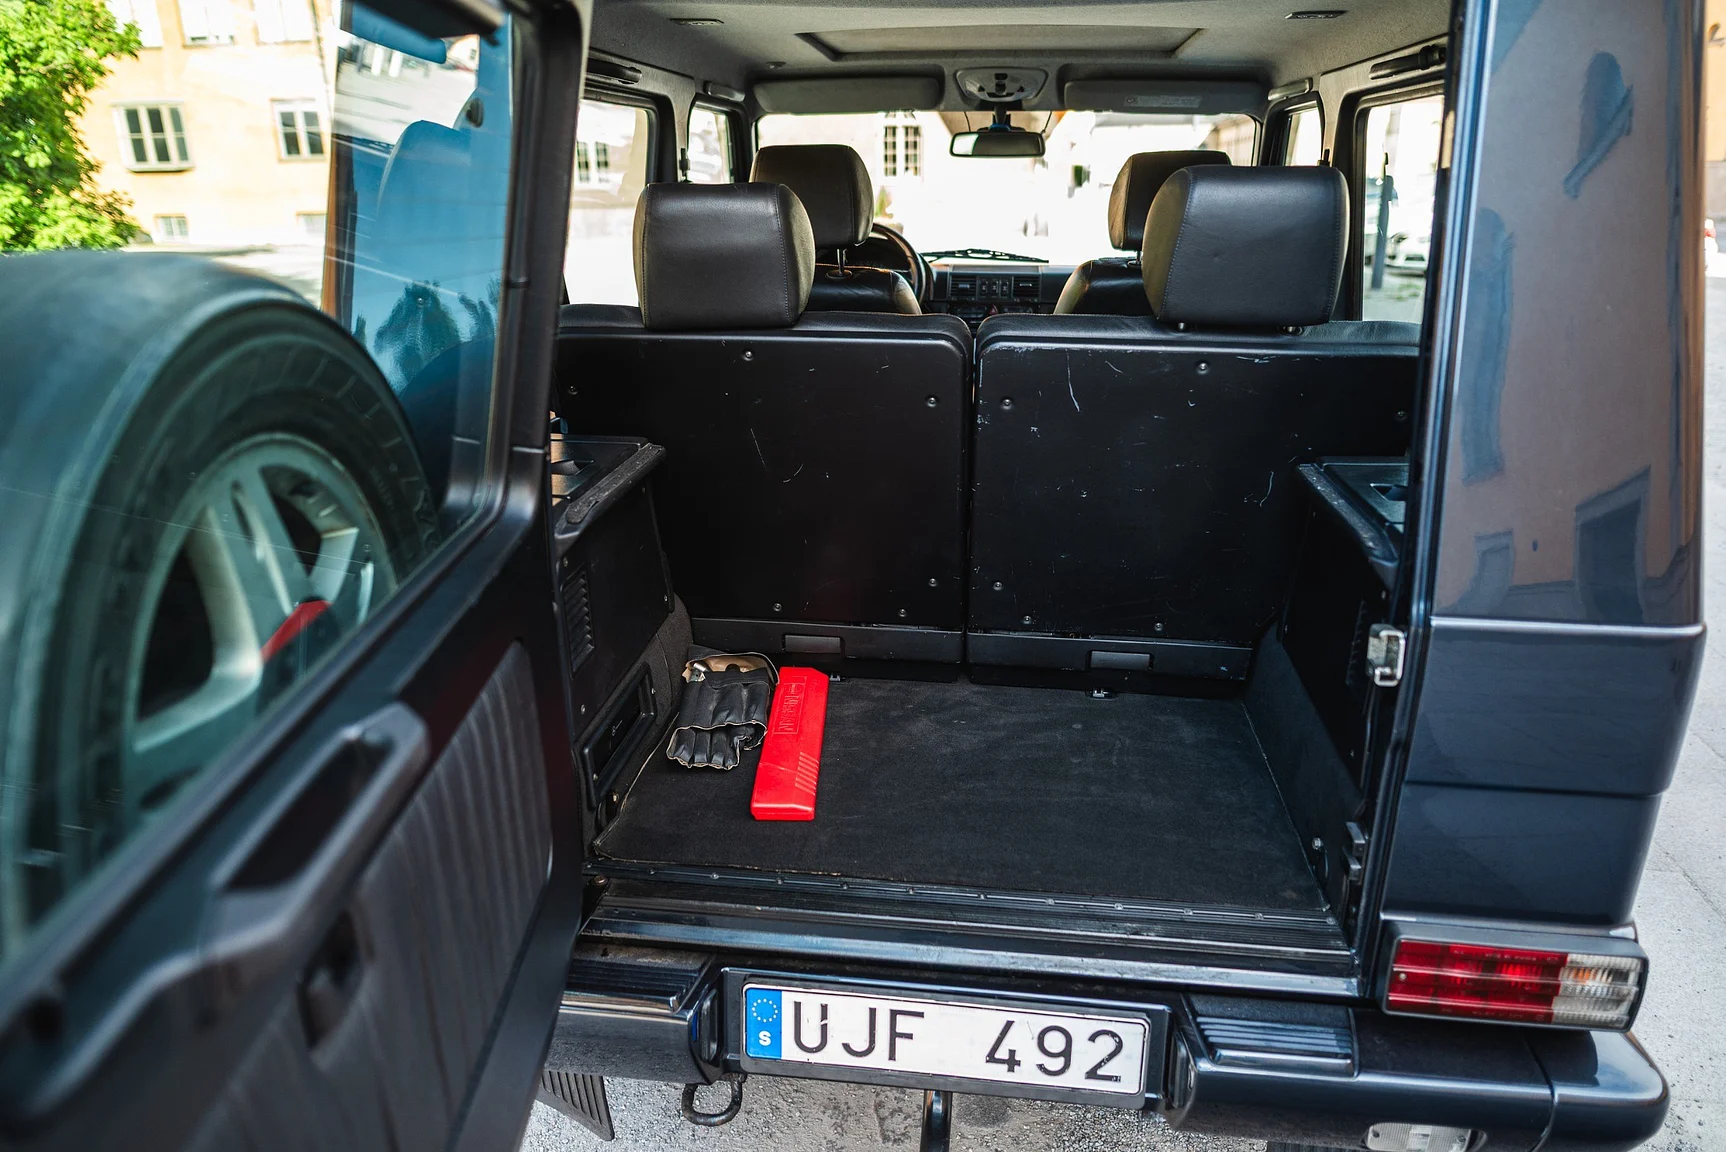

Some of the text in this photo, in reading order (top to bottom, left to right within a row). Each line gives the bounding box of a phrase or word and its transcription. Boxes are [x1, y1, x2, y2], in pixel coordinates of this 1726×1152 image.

[758, 1030, 771, 1046] S
[793, 1000, 1124, 1083] UJF 492
